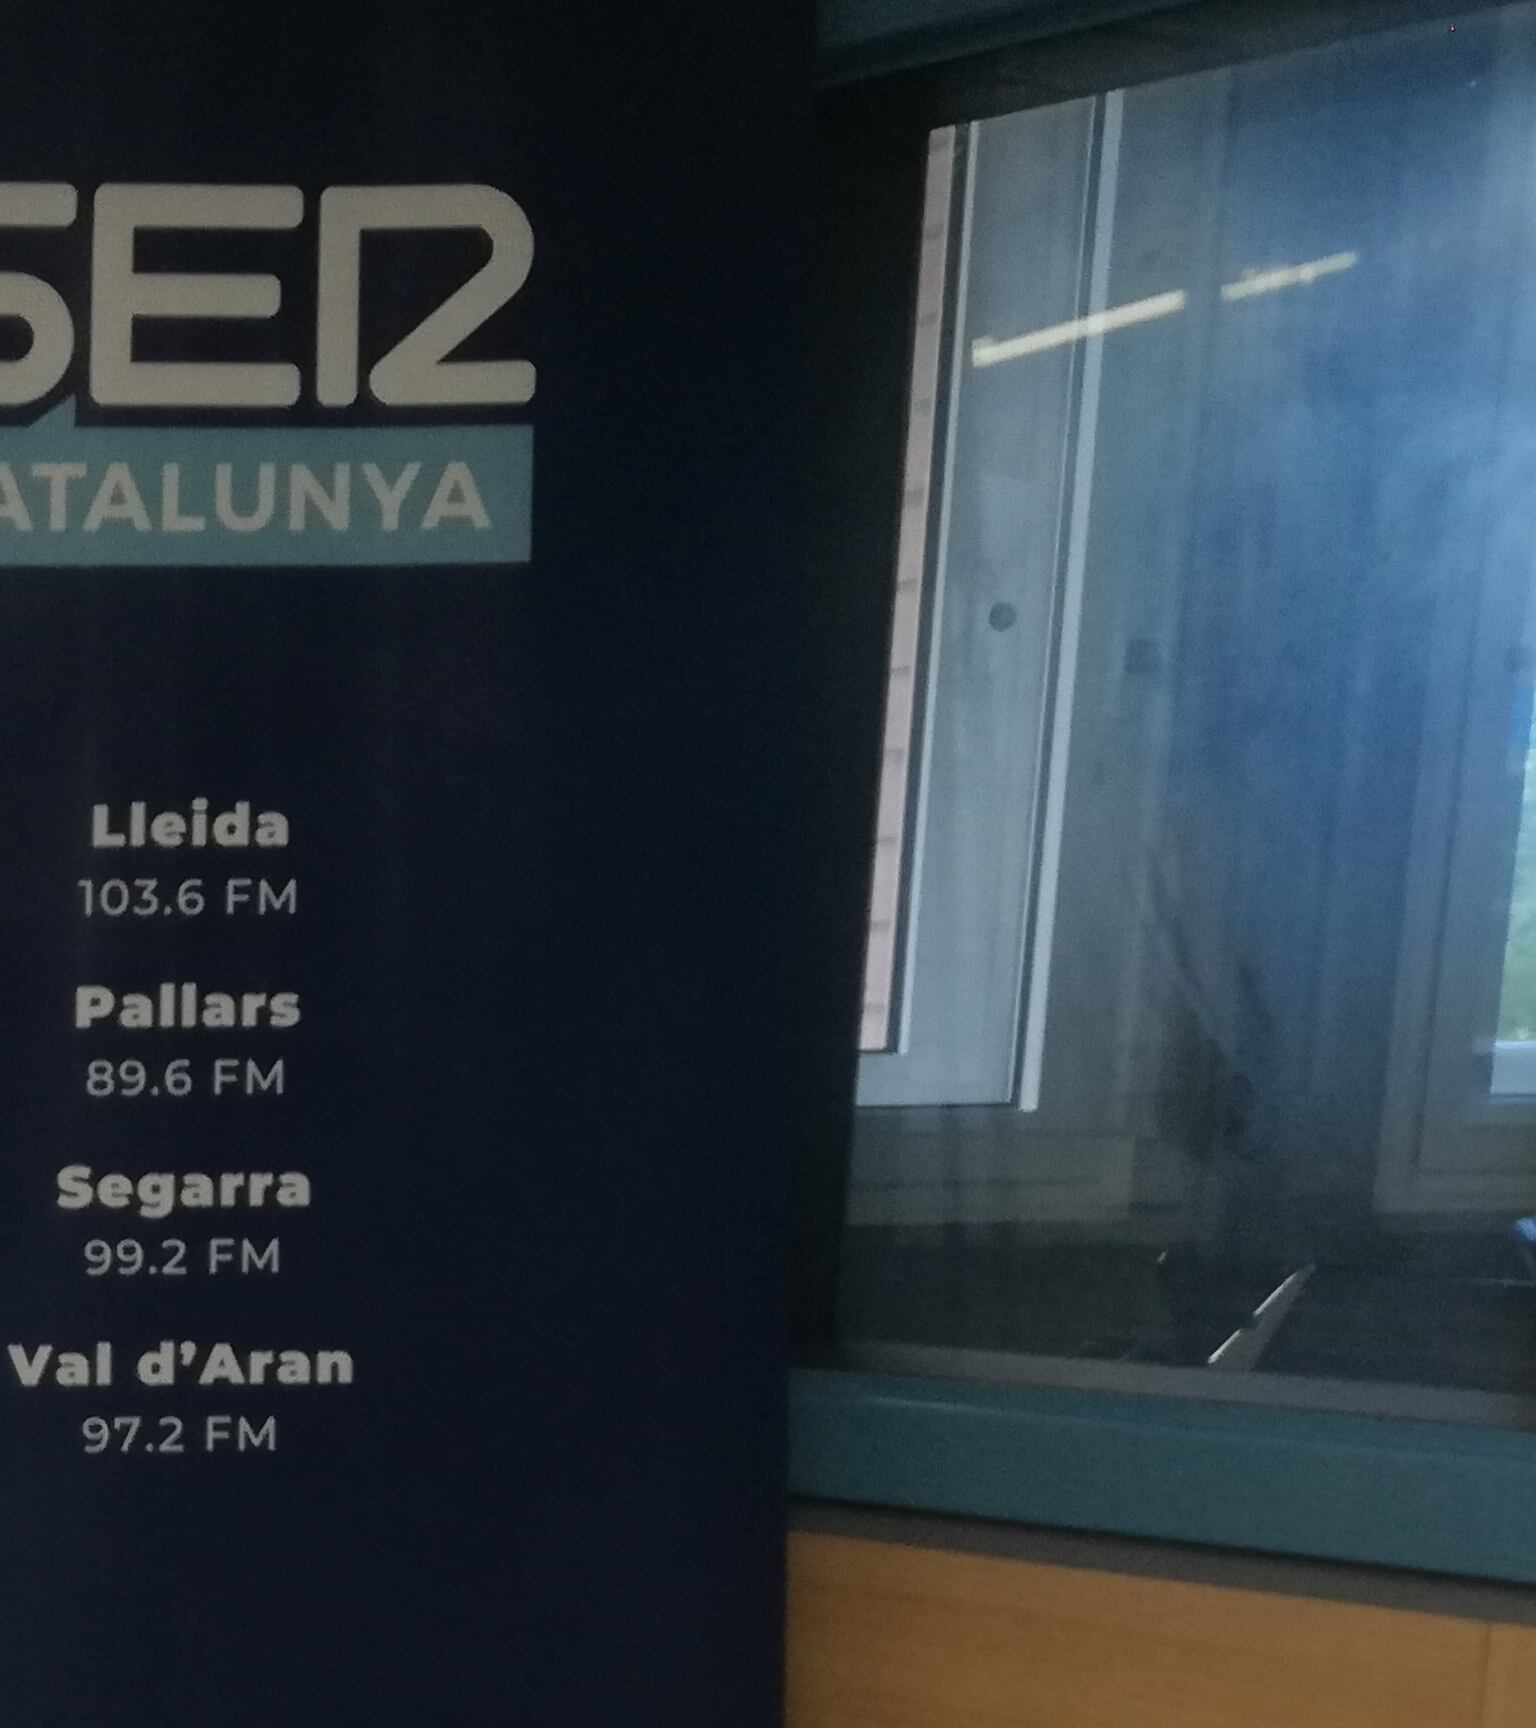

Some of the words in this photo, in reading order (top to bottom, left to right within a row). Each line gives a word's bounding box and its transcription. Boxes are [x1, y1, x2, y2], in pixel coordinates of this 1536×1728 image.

[91, 797, 290, 849] Lleida
[78, 877, 205, 918] 103.6
[226, 877, 297, 916] FM
[74, 982, 301, 1029] Pallars
[86, 1059, 193, 1097] 89.6
[213, 1059, 285, 1096] FM
[56, 1164, 311, 1219] Segarra
[84, 1238, 187, 1276] 99.2
[209, 1237, 280, 1275] FM
[7, 1341, 112, 1387] Val
[82, 1416, 185, 1454] 97.2
[206, 1415, 277, 1453] FM
